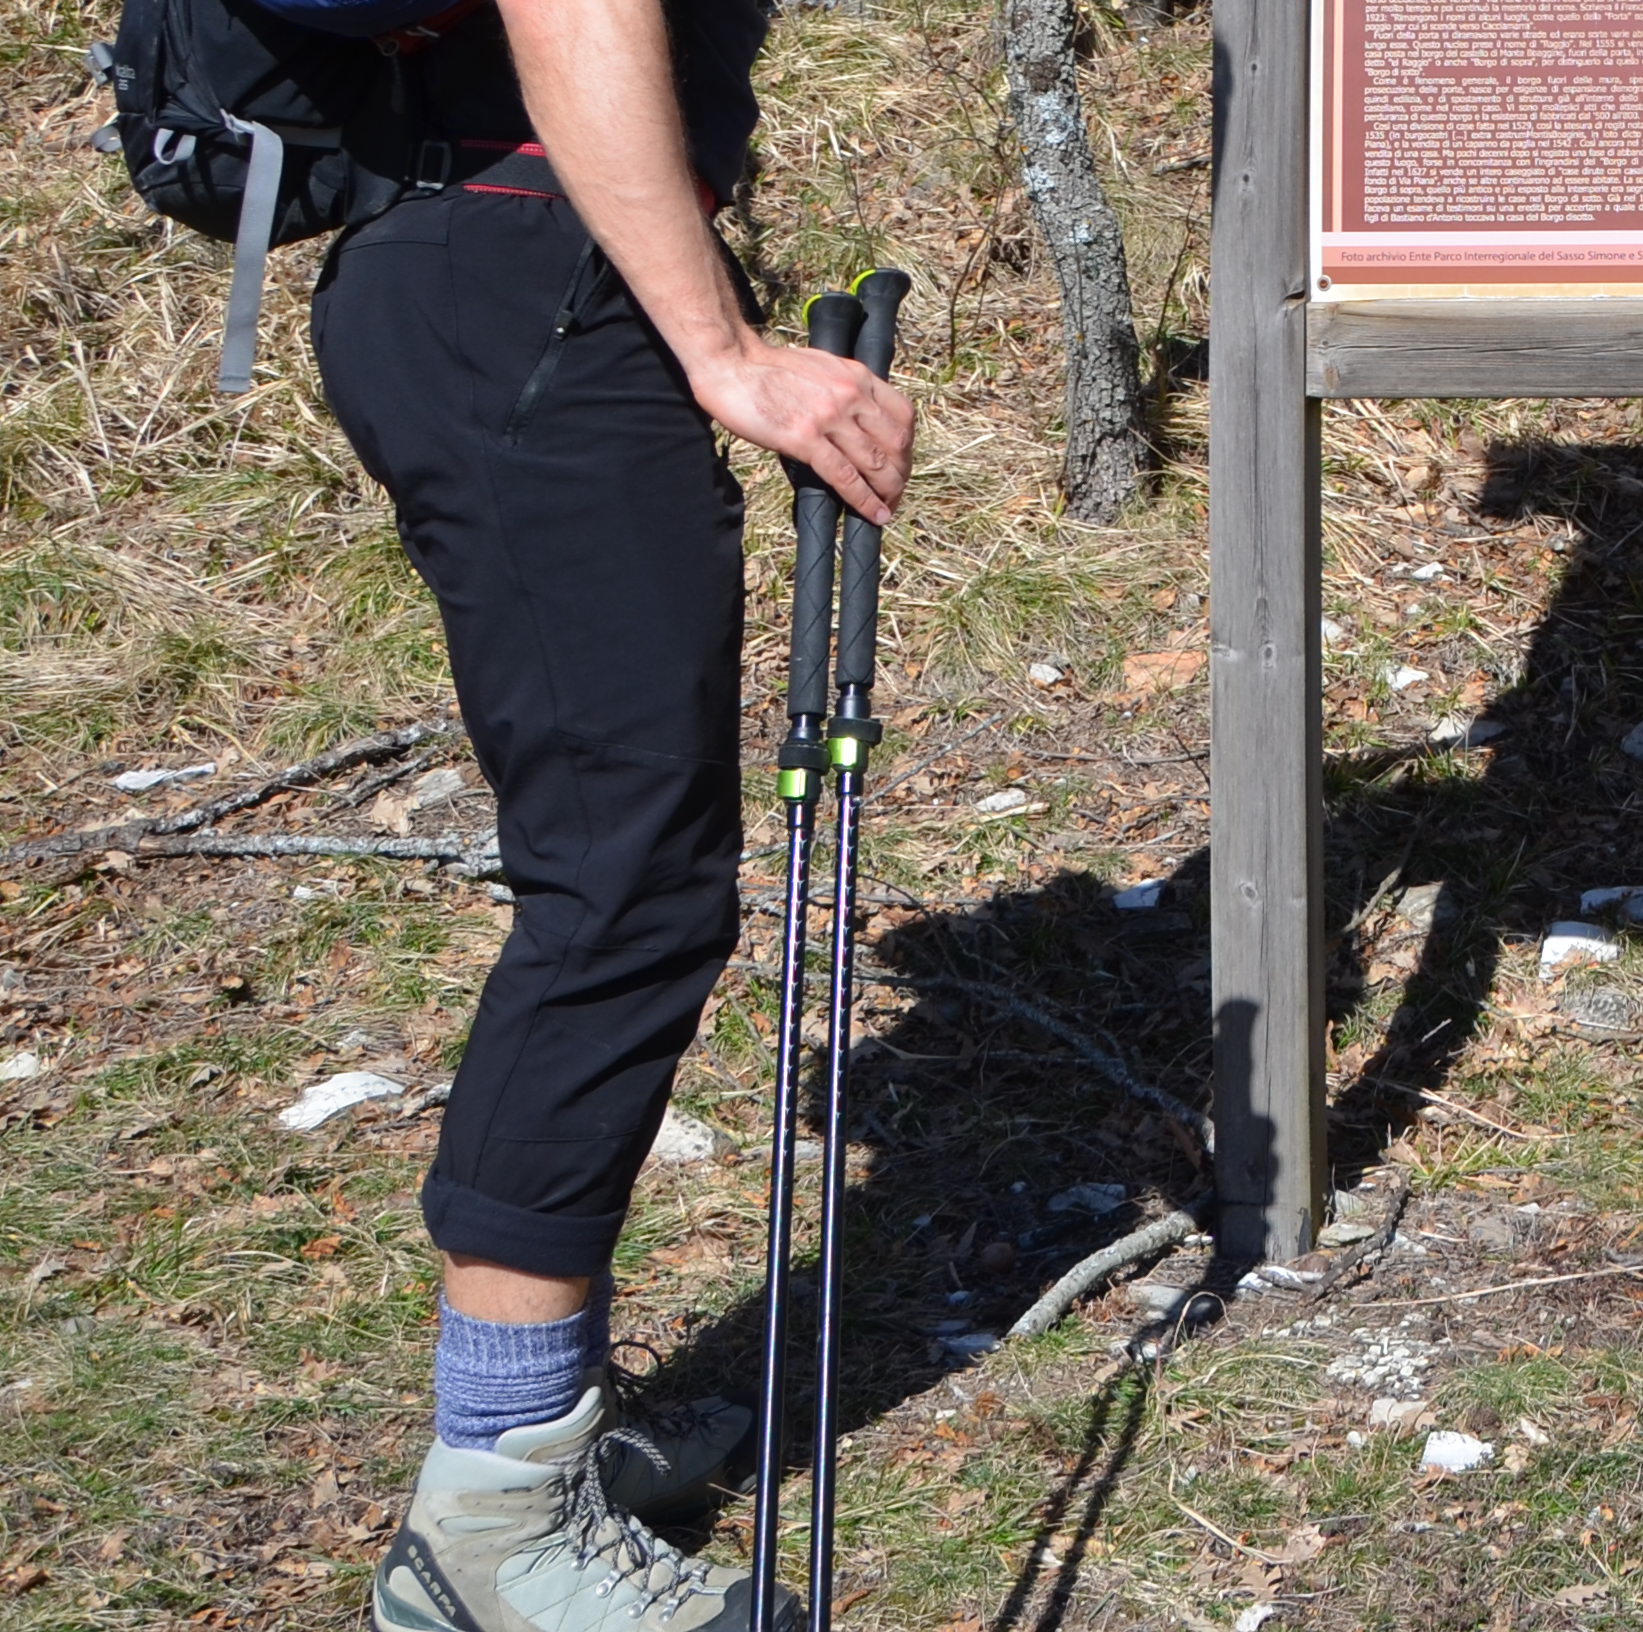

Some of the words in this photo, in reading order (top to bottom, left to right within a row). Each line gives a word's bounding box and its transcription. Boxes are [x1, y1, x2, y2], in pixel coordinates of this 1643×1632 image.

[1340, 251, 1364, 262] Foto
[1365, 251, 1407, 261] archivio
[1409, 251, 1432, 261] Ente
[1433, 251, 1462, 261] Parco
[1464, 251, 1536, 263] Interregionale
[1537, 250, 1554, 261] del
[1556, 250, 1585, 261] Sasso
[1587, 250, 1626, 260] Simone
[407, 1544, 457, 1618] SCARPA
